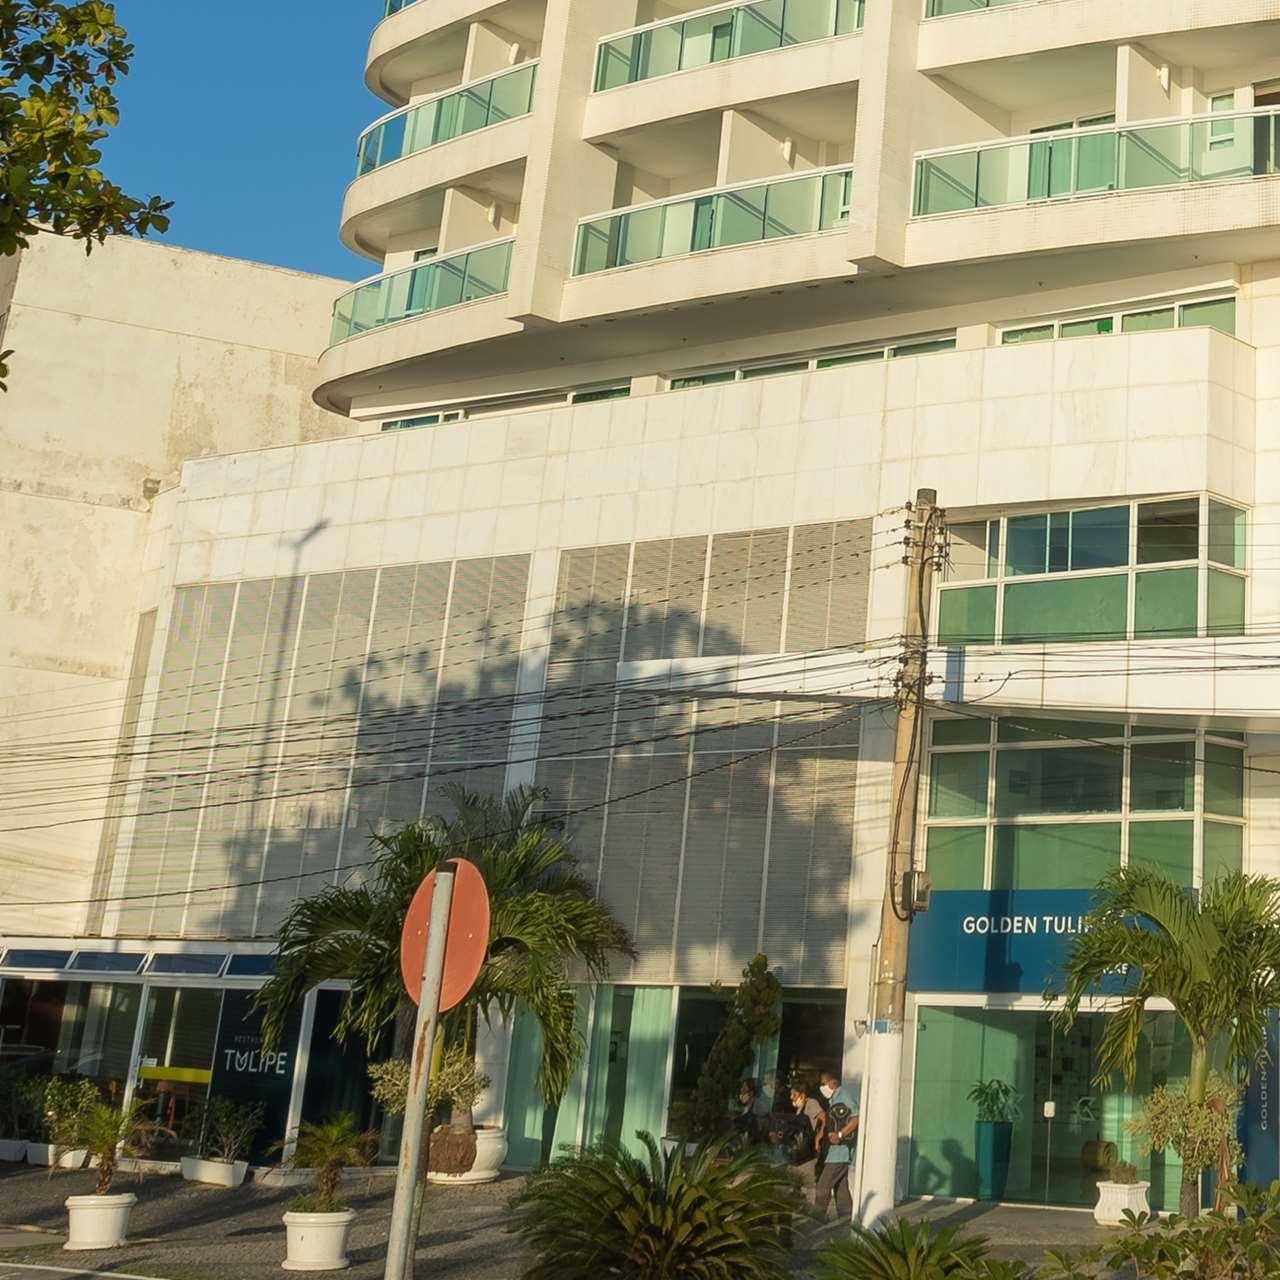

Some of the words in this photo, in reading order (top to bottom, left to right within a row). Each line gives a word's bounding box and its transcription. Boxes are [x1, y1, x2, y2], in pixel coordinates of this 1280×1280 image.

[963, 916, 1037, 934] GOLDEN
[224, 1049, 288, 1074] TULIPE
[1260, 1071, 1268, 1131] GOLDEN
